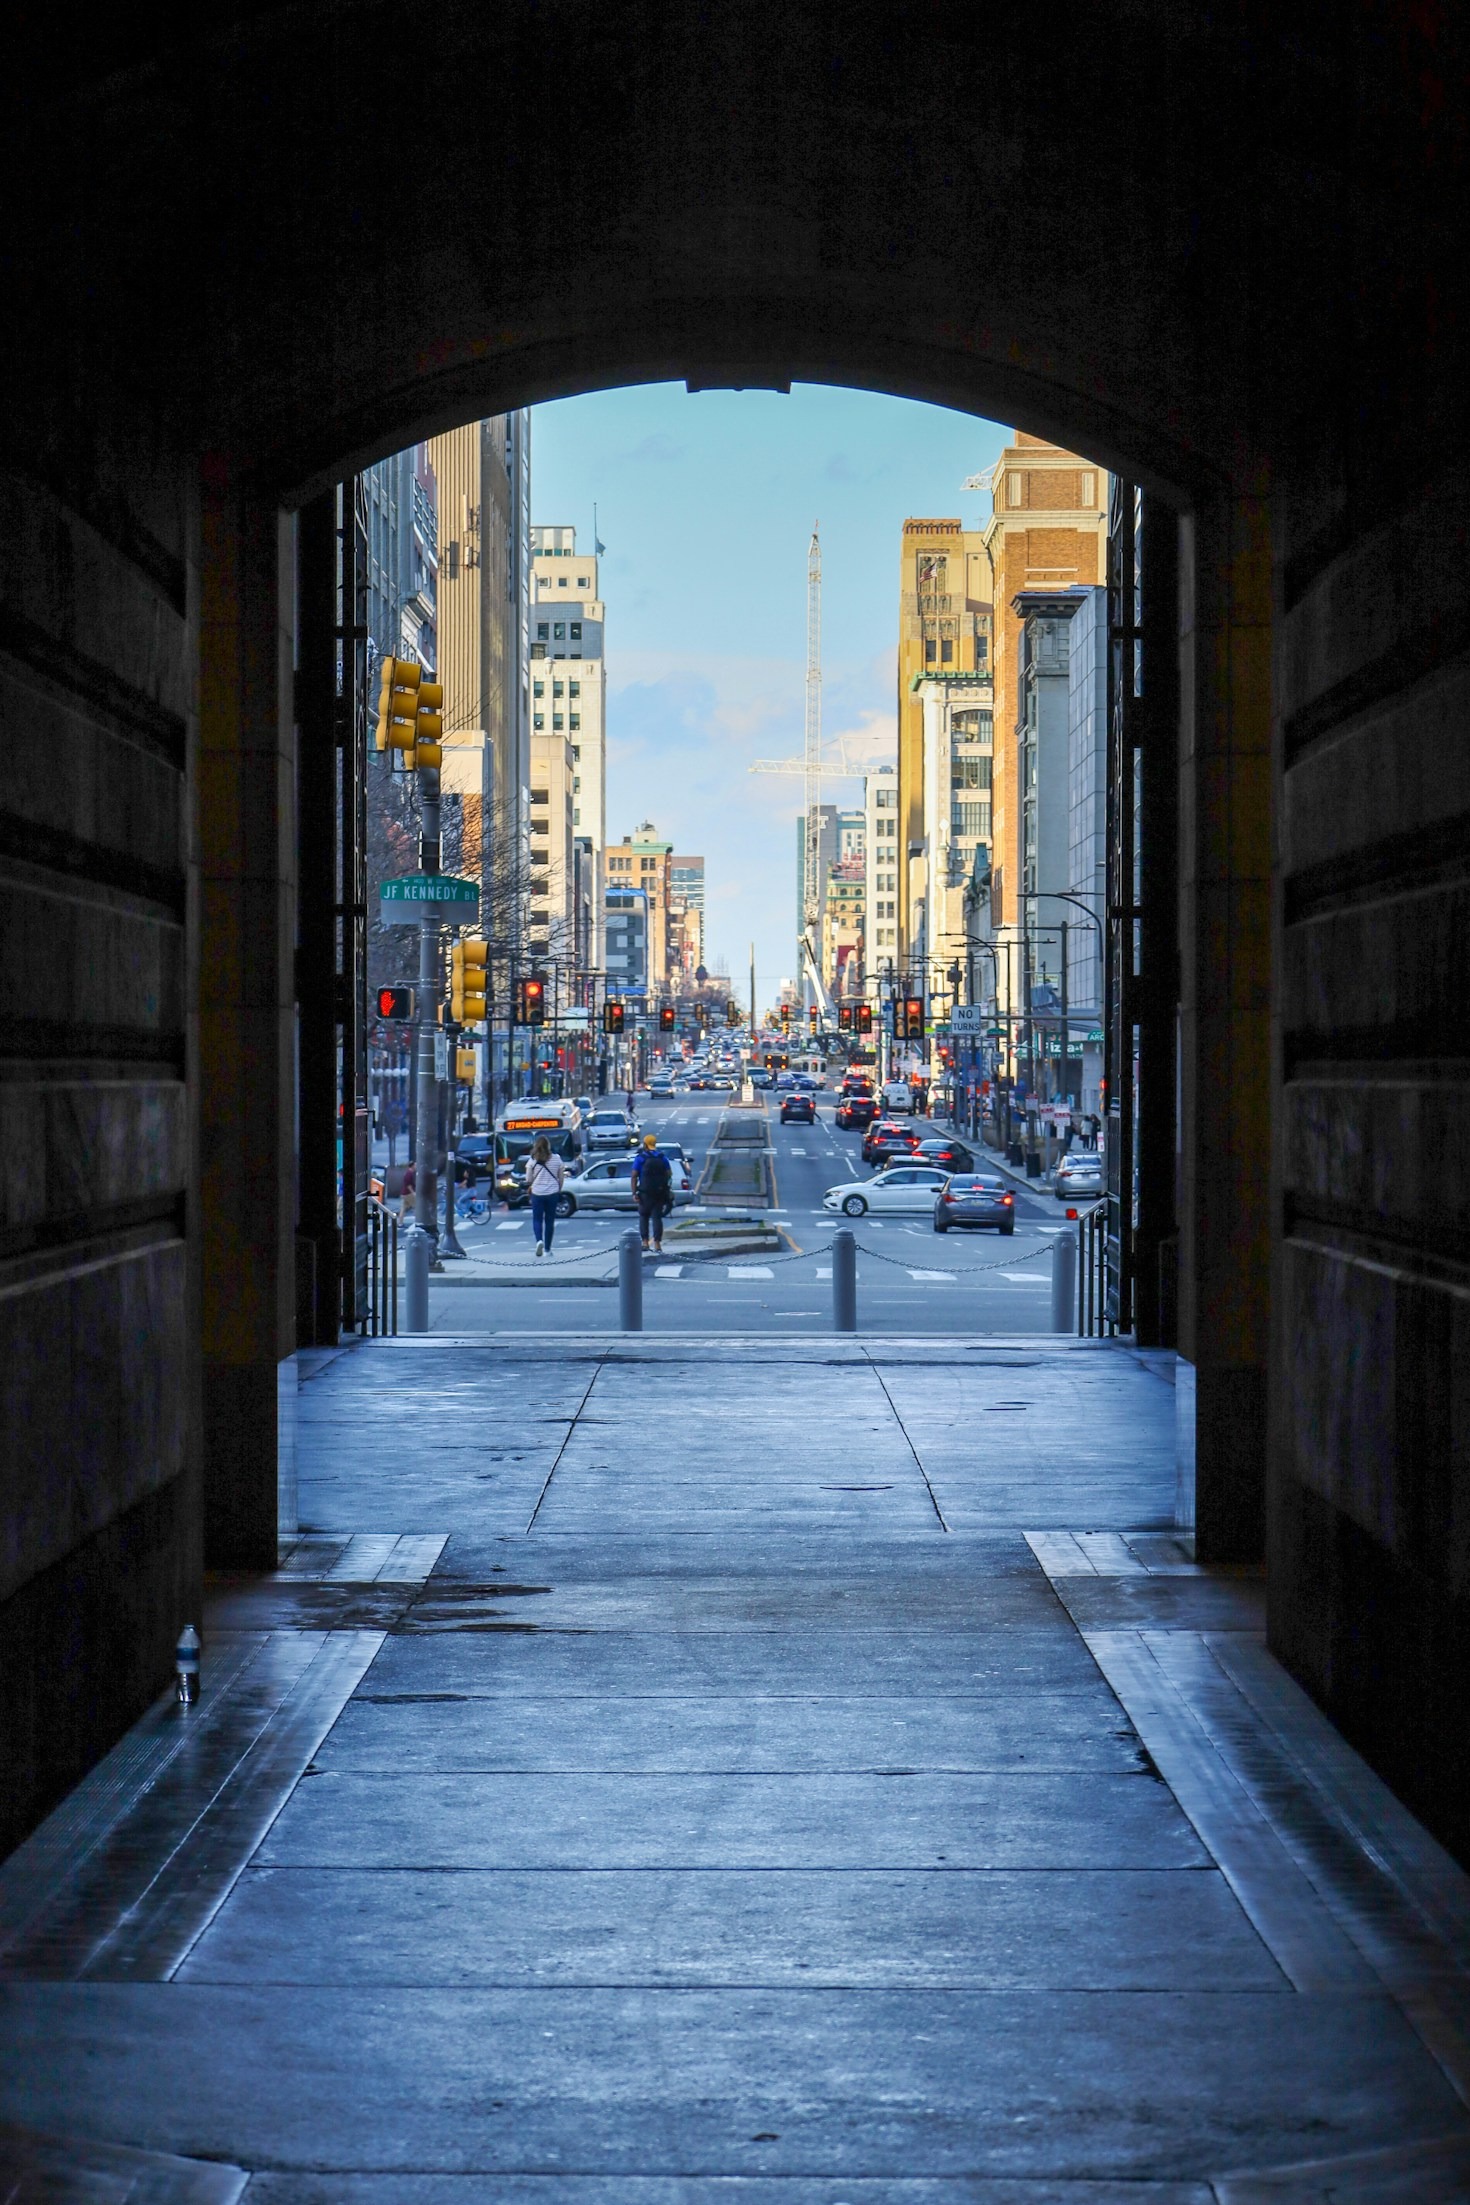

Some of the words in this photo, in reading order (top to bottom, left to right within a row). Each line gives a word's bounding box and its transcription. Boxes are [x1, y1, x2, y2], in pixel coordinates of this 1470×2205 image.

[383, 885, 398, 899] JF
[404, 886, 458, 899] KENNEDY
[464, 891, 476, 901] BL
[958, 1009, 973, 1019] NO
[953, 1022, 979, 1031] TURNS
[507, 1121, 515, 1130] 27
